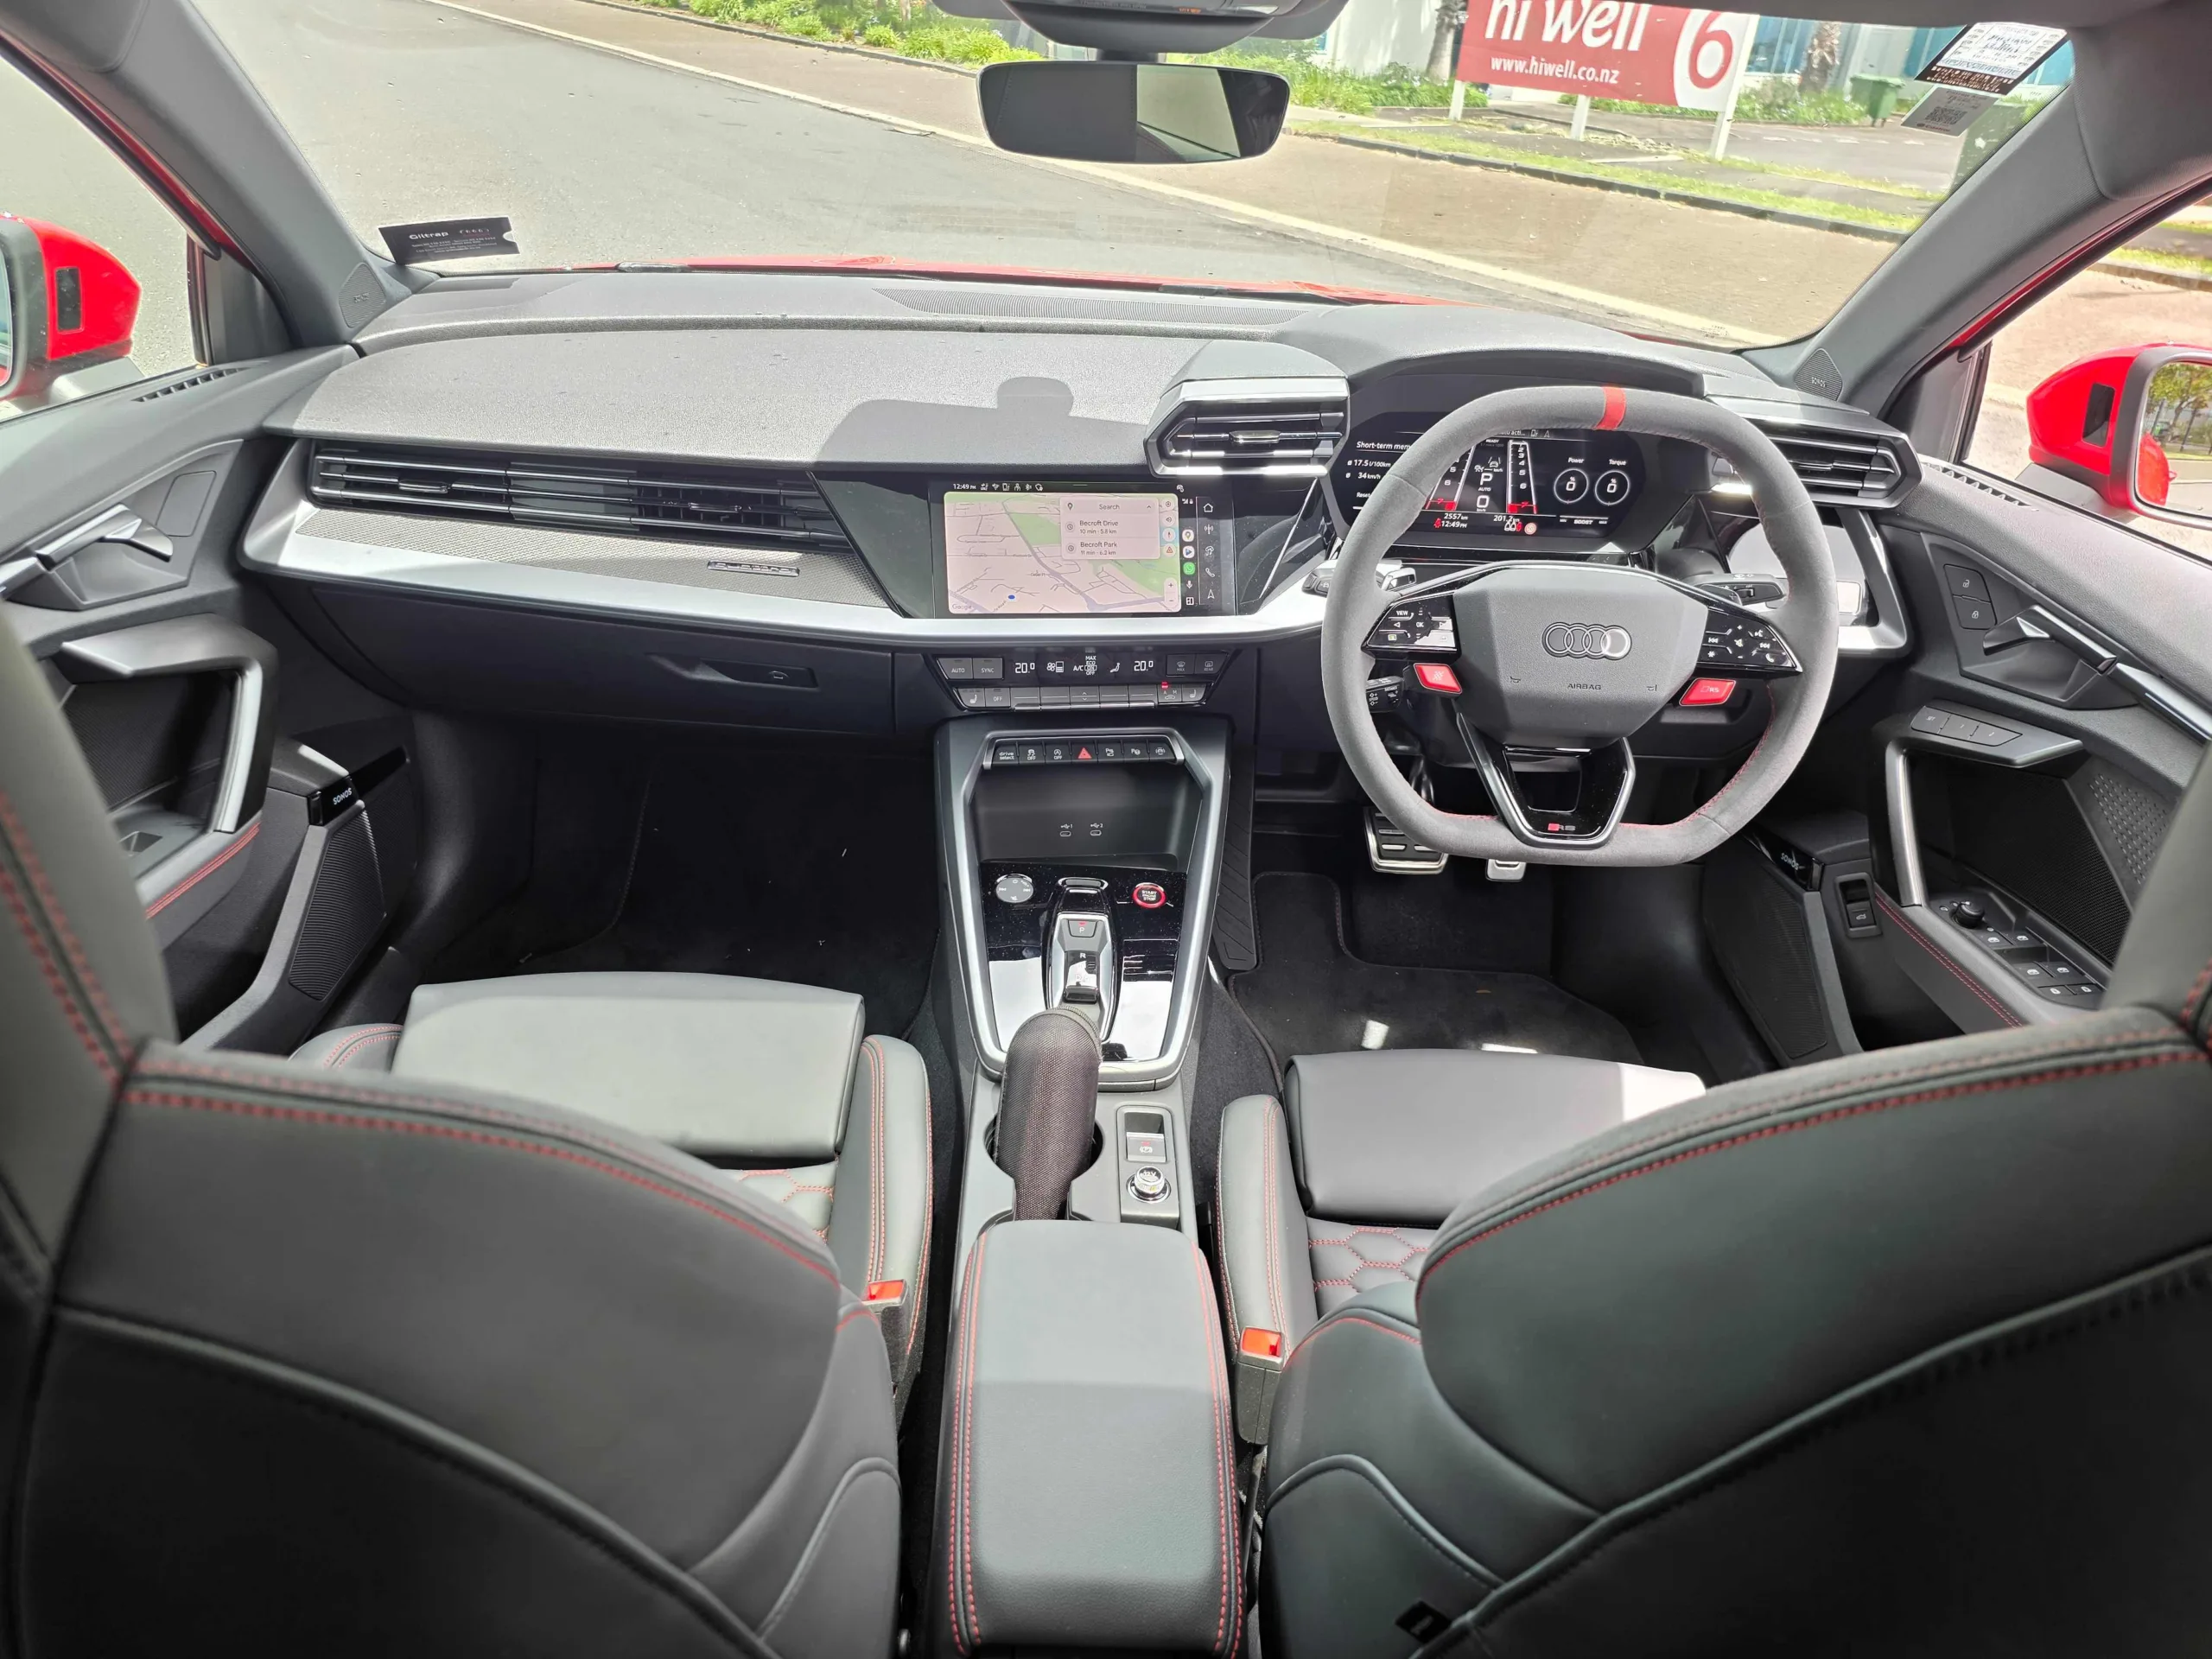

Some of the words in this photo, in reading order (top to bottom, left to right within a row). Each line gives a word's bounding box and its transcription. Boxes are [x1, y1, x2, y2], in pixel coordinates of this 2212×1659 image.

[1541, 0, 1652, 51] well
[1688, 10, 1733, 90] 6
[1491, 55, 1620, 85] www.hiwell.co.nz
[1356, 441, 1393, 449] Short-term
[1480, 473, 1493, 486] P
[333, 787, 353, 805] SONOS
[1781, 852, 1800, 871] SONOS
